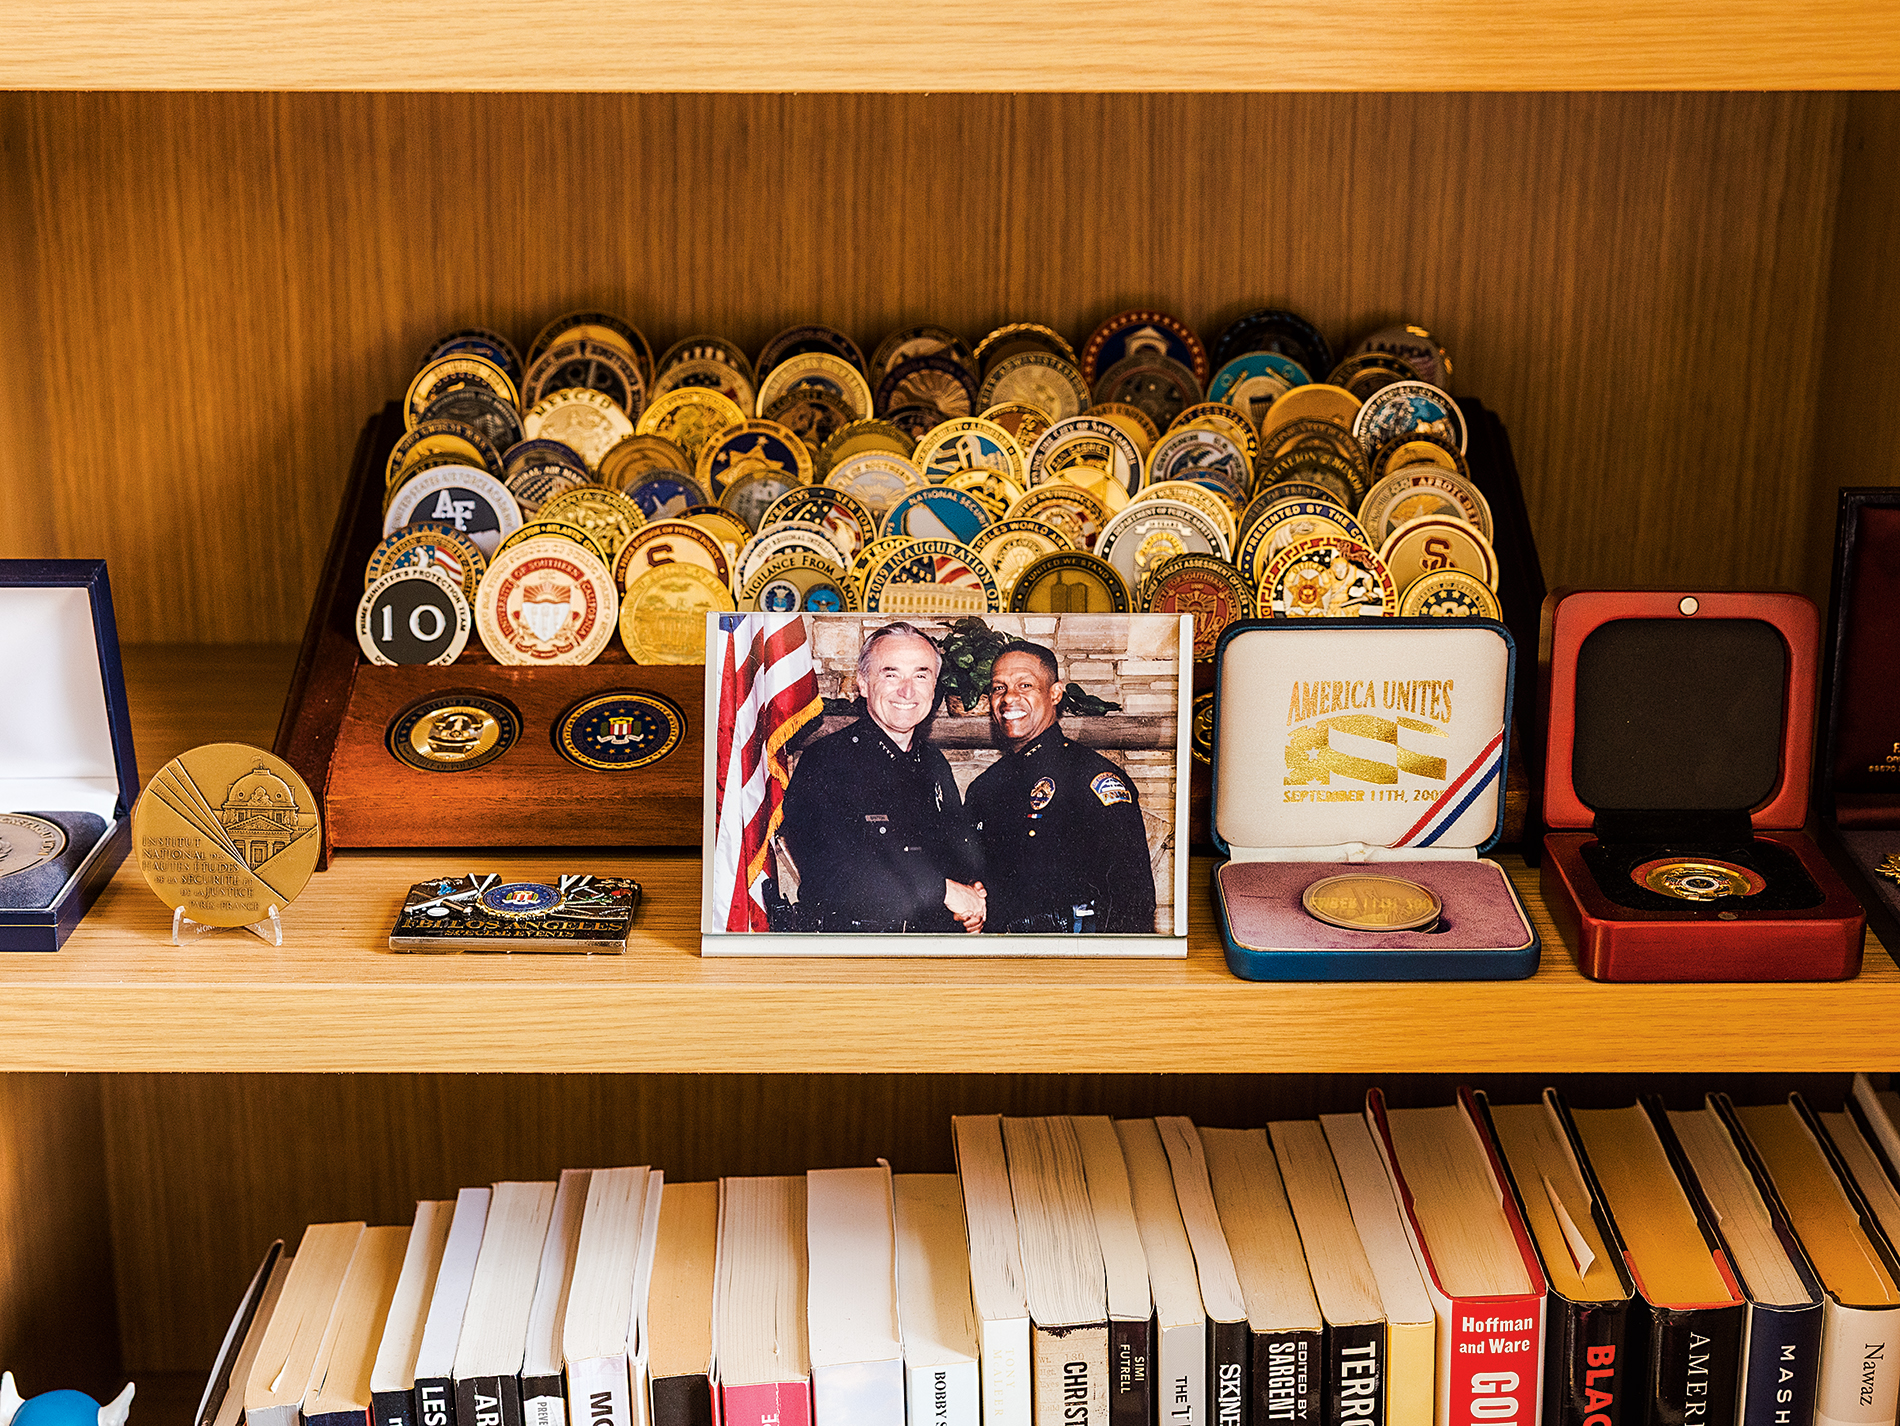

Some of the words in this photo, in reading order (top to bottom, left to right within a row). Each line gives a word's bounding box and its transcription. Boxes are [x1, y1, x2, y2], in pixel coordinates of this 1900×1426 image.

[906, 489, 959, 506] NATIONAL
[545, 524, 585, 543] ATLANTIC
[1008, 521, 1049, 535] WORLD
[1245, 504, 1301, 553] PRESENTED
[1306, 503, 1322, 514] BY
[1326, 507, 1351, 528] THE
[866, 565, 889, 599] 2009
[886, 540, 992, 585] INAUGURATION
[983, 586, 998, 607] OF
[1025, 558, 1060, 581] UNITED
[1080, 558, 1111, 580] STAND
[1156, 560, 1184, 582] THREAT
[1182, 559, 1233, 578] ASSESSMENT
[1228, 574, 1248, 605] OFFICER
[364, 568, 409, 604] MINISTER'S
[412, 567, 465, 603] PROTECTION
[742, 555, 795, 601] VIGILANCE
[802, 555, 837, 574] FROM
[835, 572, 859, 612] ABOVE
[382, 603, 447, 642] 10
[1286, 680, 1377, 727] AMERICA
[1383, 679, 1454, 724] UNITES
[1283, 789, 1365, 803] SEPTEMBER
[1369, 789, 1408, 803] 11TH,
[142, 835, 201, 848] INSTITUT
[142, 848, 206, 860] NATIONAL
[142, 861, 190, 872] HAUTES
[203, 888, 254, 899] JUSTICE
[220, 901, 259, 911] FRANCE
[449, 920, 501, 930] LOS
[503, 920, 623, 932] ANGELES
[513, 930, 576, 938] EVENTS
[1462, 1316, 1533, 1333] Hoffman
[1459, 1341, 1485, 1353] and
[1488, 1338, 1530, 1354] Ware
[1005, 1348, 1016, 1388] TONY
[1120, 1344, 1131, 1394] FUTRELL
[1134, 1356, 1145, 1382] SIMI
[1268, 1342, 1296, 1420] SARGENT
[1297, 1341, 1308, 1395] EDITED
[1859, 1342, 1885, 1407] Nawaz
[934, 1371, 947, 1418] BOBBY
[992, 1349, 1005, 1417] McALEER
[1175, 1376, 1188, 1404] THE
[1774, 1345, 1796, 1424] MASH
[1297, 1399, 1308, 1420] BY
